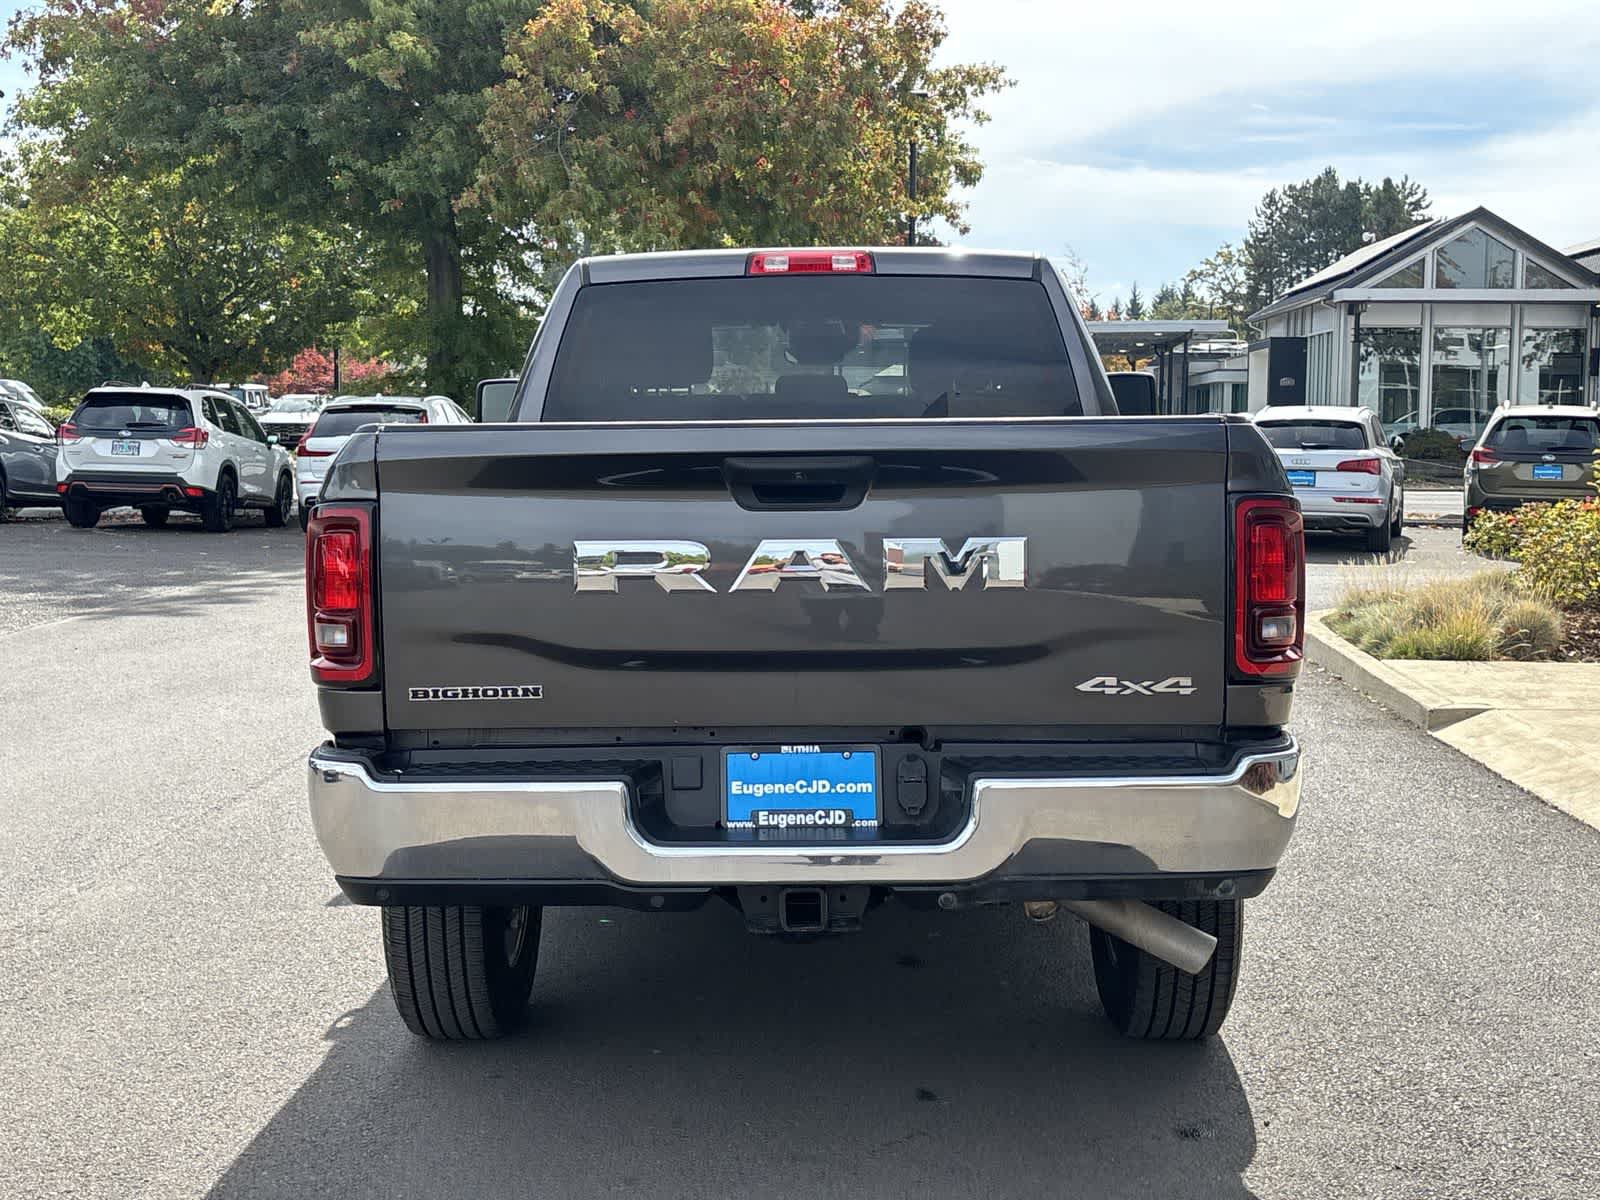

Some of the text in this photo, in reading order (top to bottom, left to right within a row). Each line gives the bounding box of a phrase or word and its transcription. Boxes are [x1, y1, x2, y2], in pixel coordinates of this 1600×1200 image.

[573, 537, 1028, 593] RAM
[409, 686, 542, 701] BIGHORN
[789, 745, 820, 753] LITHIA
[731, 780, 873, 797] EugeneCJD.com
[758, 810, 846, 828] EugeneCJD
